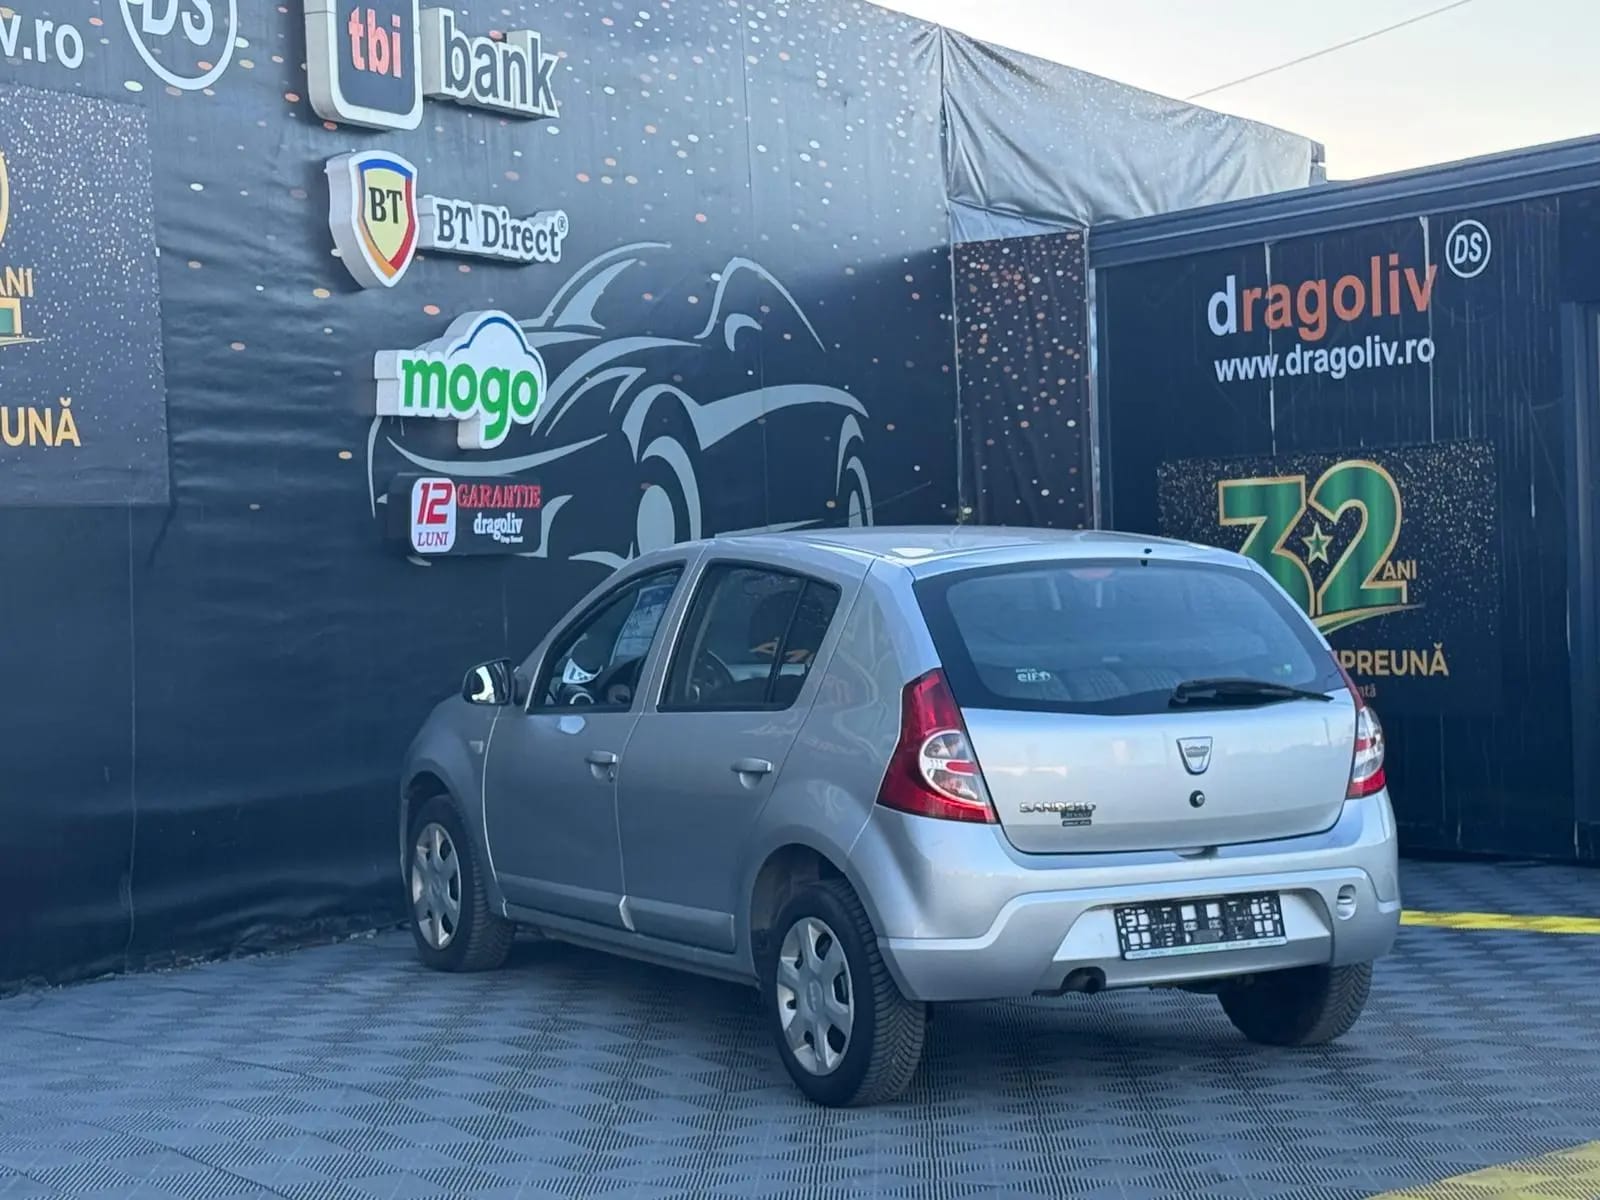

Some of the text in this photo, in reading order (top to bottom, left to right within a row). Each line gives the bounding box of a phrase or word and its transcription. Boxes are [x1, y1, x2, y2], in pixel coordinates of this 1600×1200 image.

[348, 6, 558, 113] tbi bank
[368, 186, 403, 225] BT
[436, 203, 473, 245] BT
[1453, 232, 1484, 265] DS
[1207, 253, 1438, 342] dragoliv
[1214, 335, 1436, 383] www.dragoliv.ro
[402, 358, 539, 441] mogo
[416, 482, 453, 525] 12
[457, 484, 542, 509] GARANTIE
[417, 531, 449, 547] LUNI
[473, 511, 524, 541] dragoliv
[1217, 459, 1408, 618] 32
[1382, 559, 1418, 582] ANI
[1332, 641, 1449, 676] PREUNĂ
